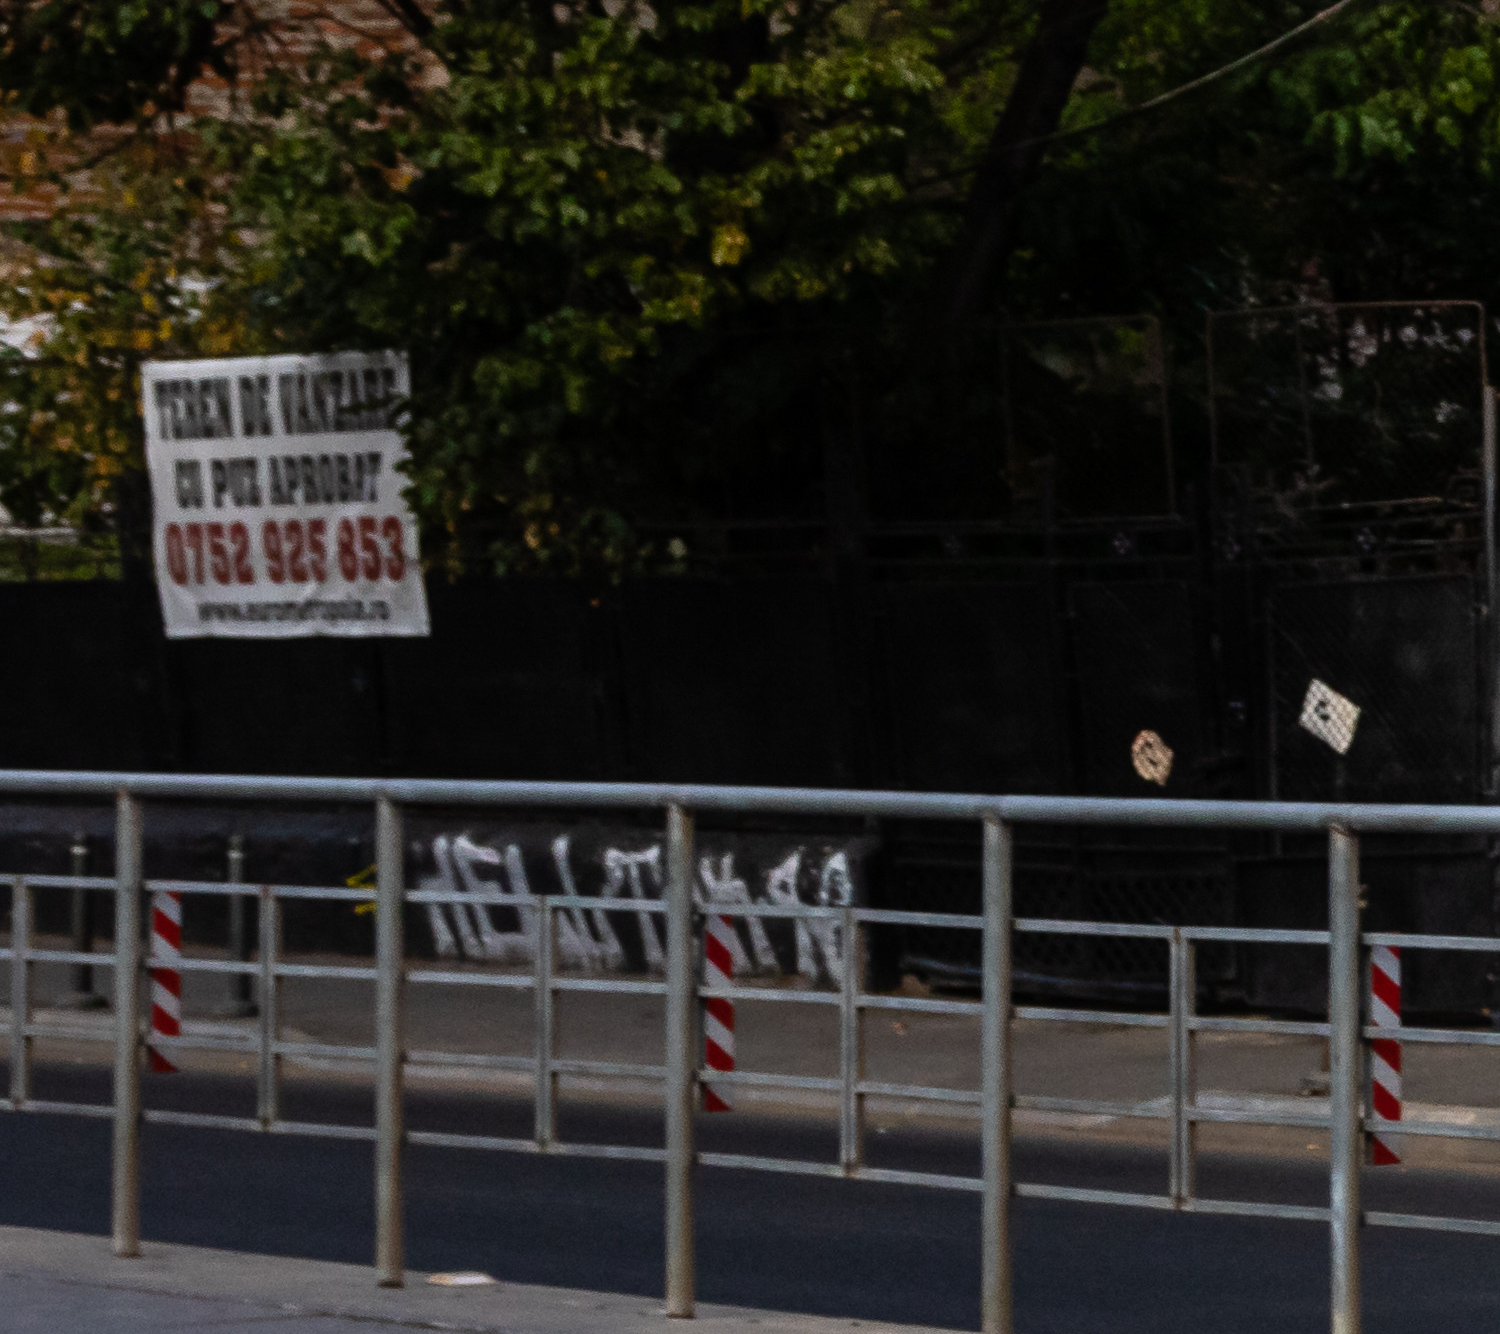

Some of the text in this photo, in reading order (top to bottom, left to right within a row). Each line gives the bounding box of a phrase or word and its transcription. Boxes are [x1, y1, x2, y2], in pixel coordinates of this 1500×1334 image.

[237, 374, 273, 437] DE
[165, 515, 406, 585] 0752 925 853
